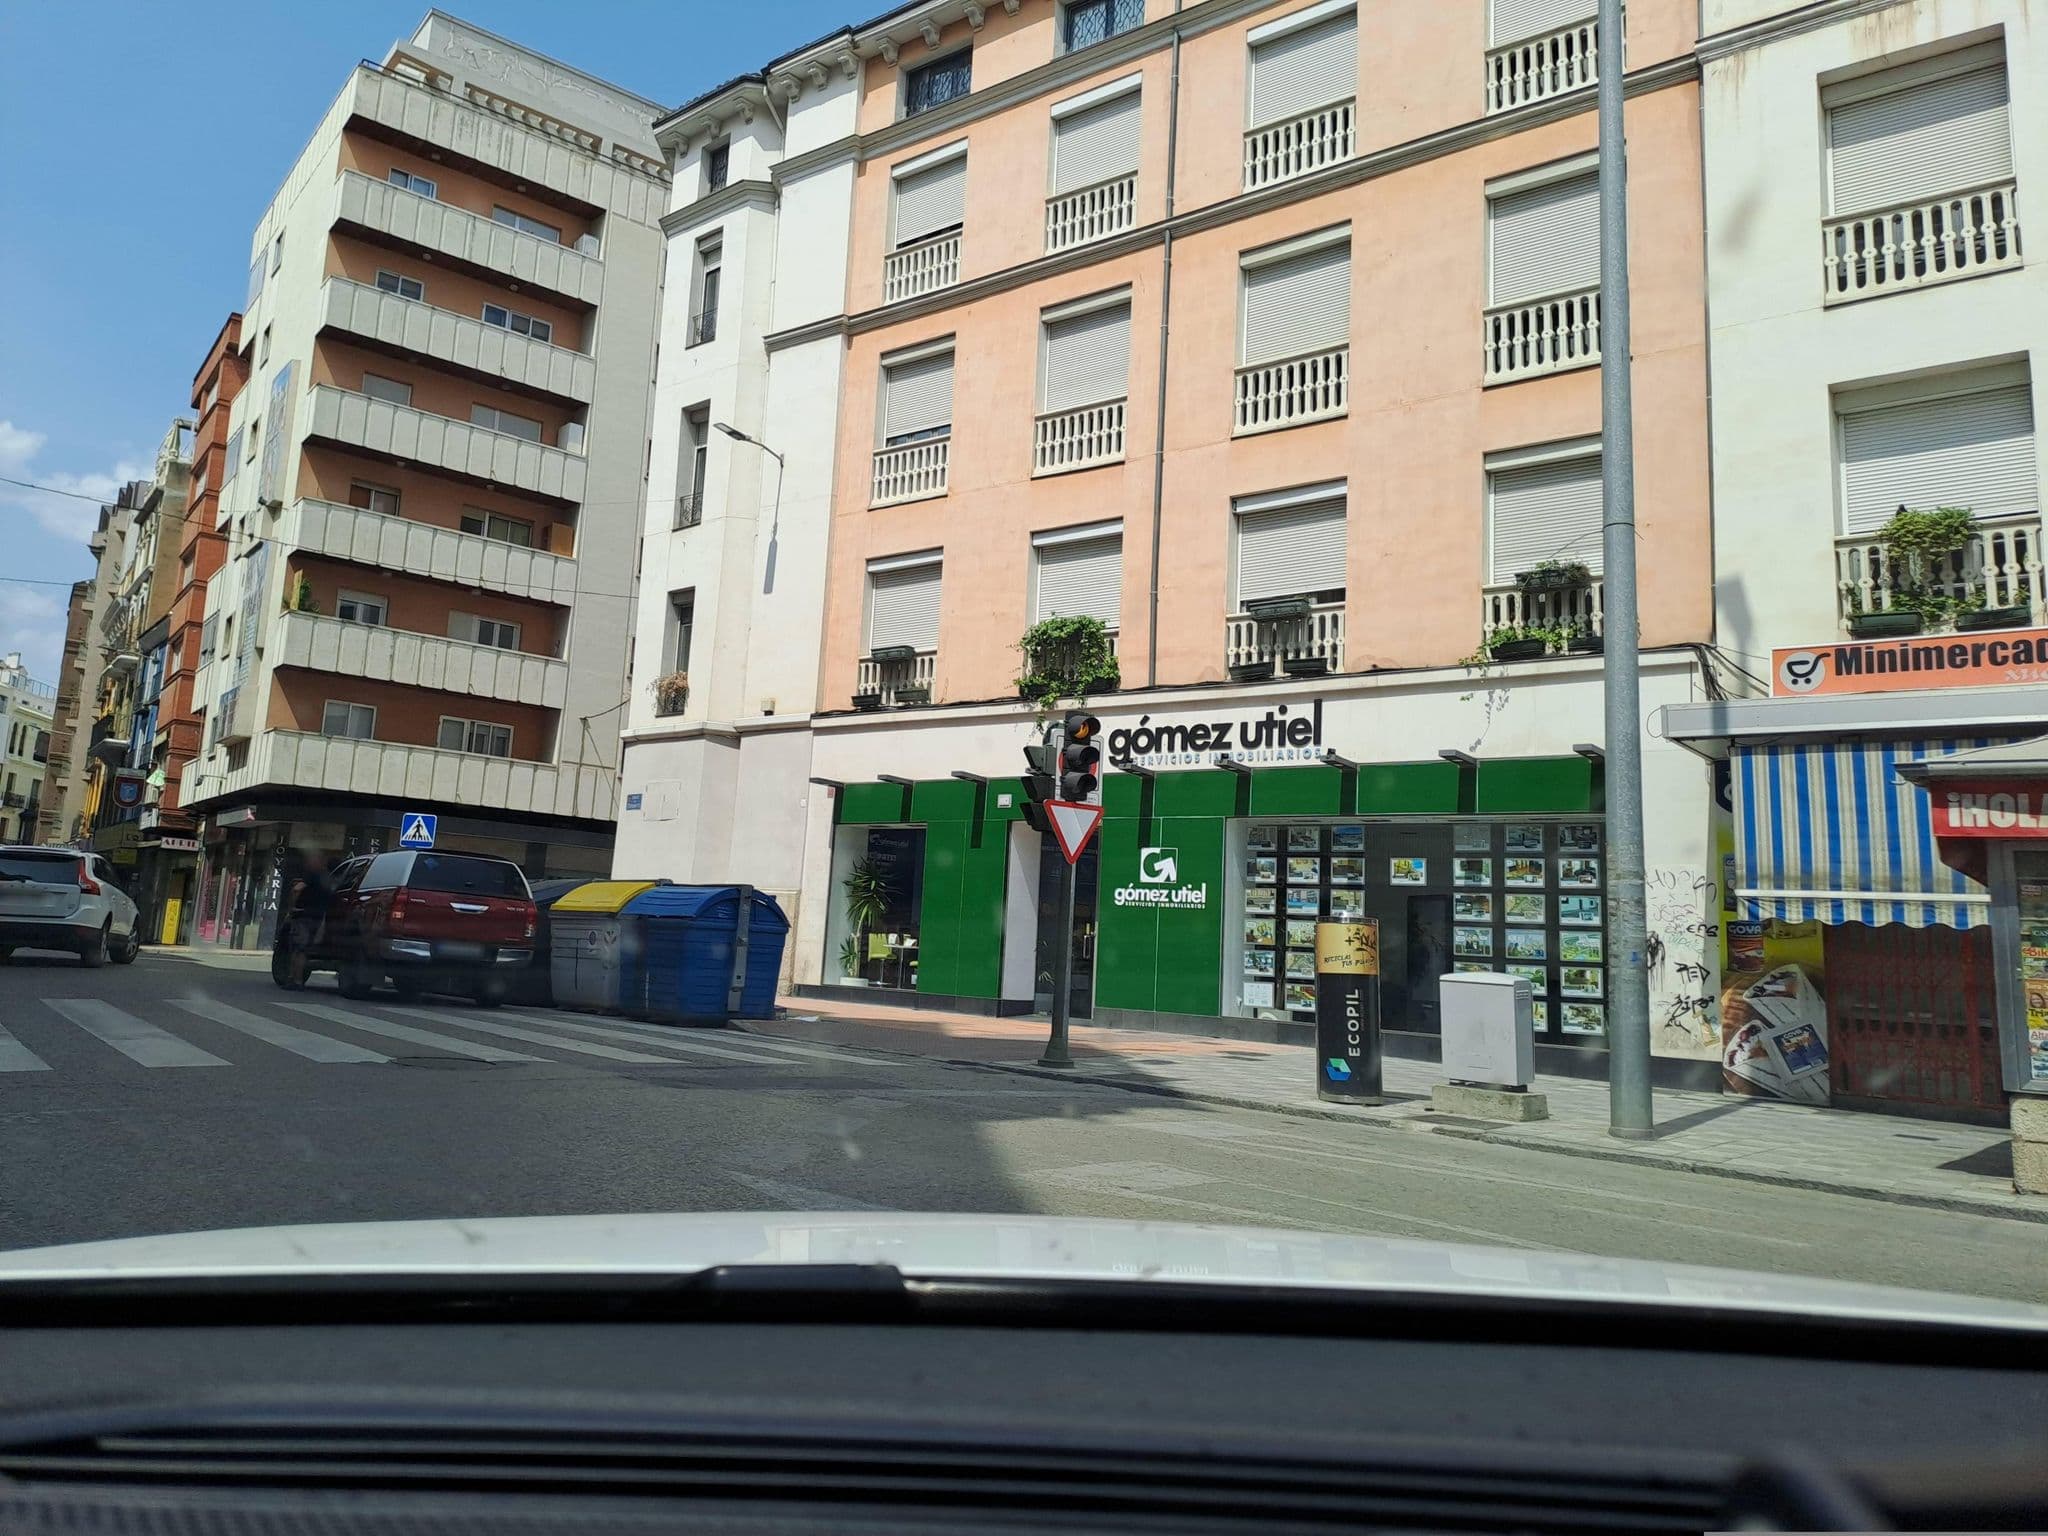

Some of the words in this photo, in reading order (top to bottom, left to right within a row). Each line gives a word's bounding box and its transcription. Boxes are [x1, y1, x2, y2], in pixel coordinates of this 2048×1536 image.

[1108, 714, 1233, 767] gómez
[1240, 699, 1323, 749] utiel
[1114, 882, 1169, 906] gómez
[1171, 882, 1206, 903] utiel
[1345, 988, 1361, 1057] ECOPIL
